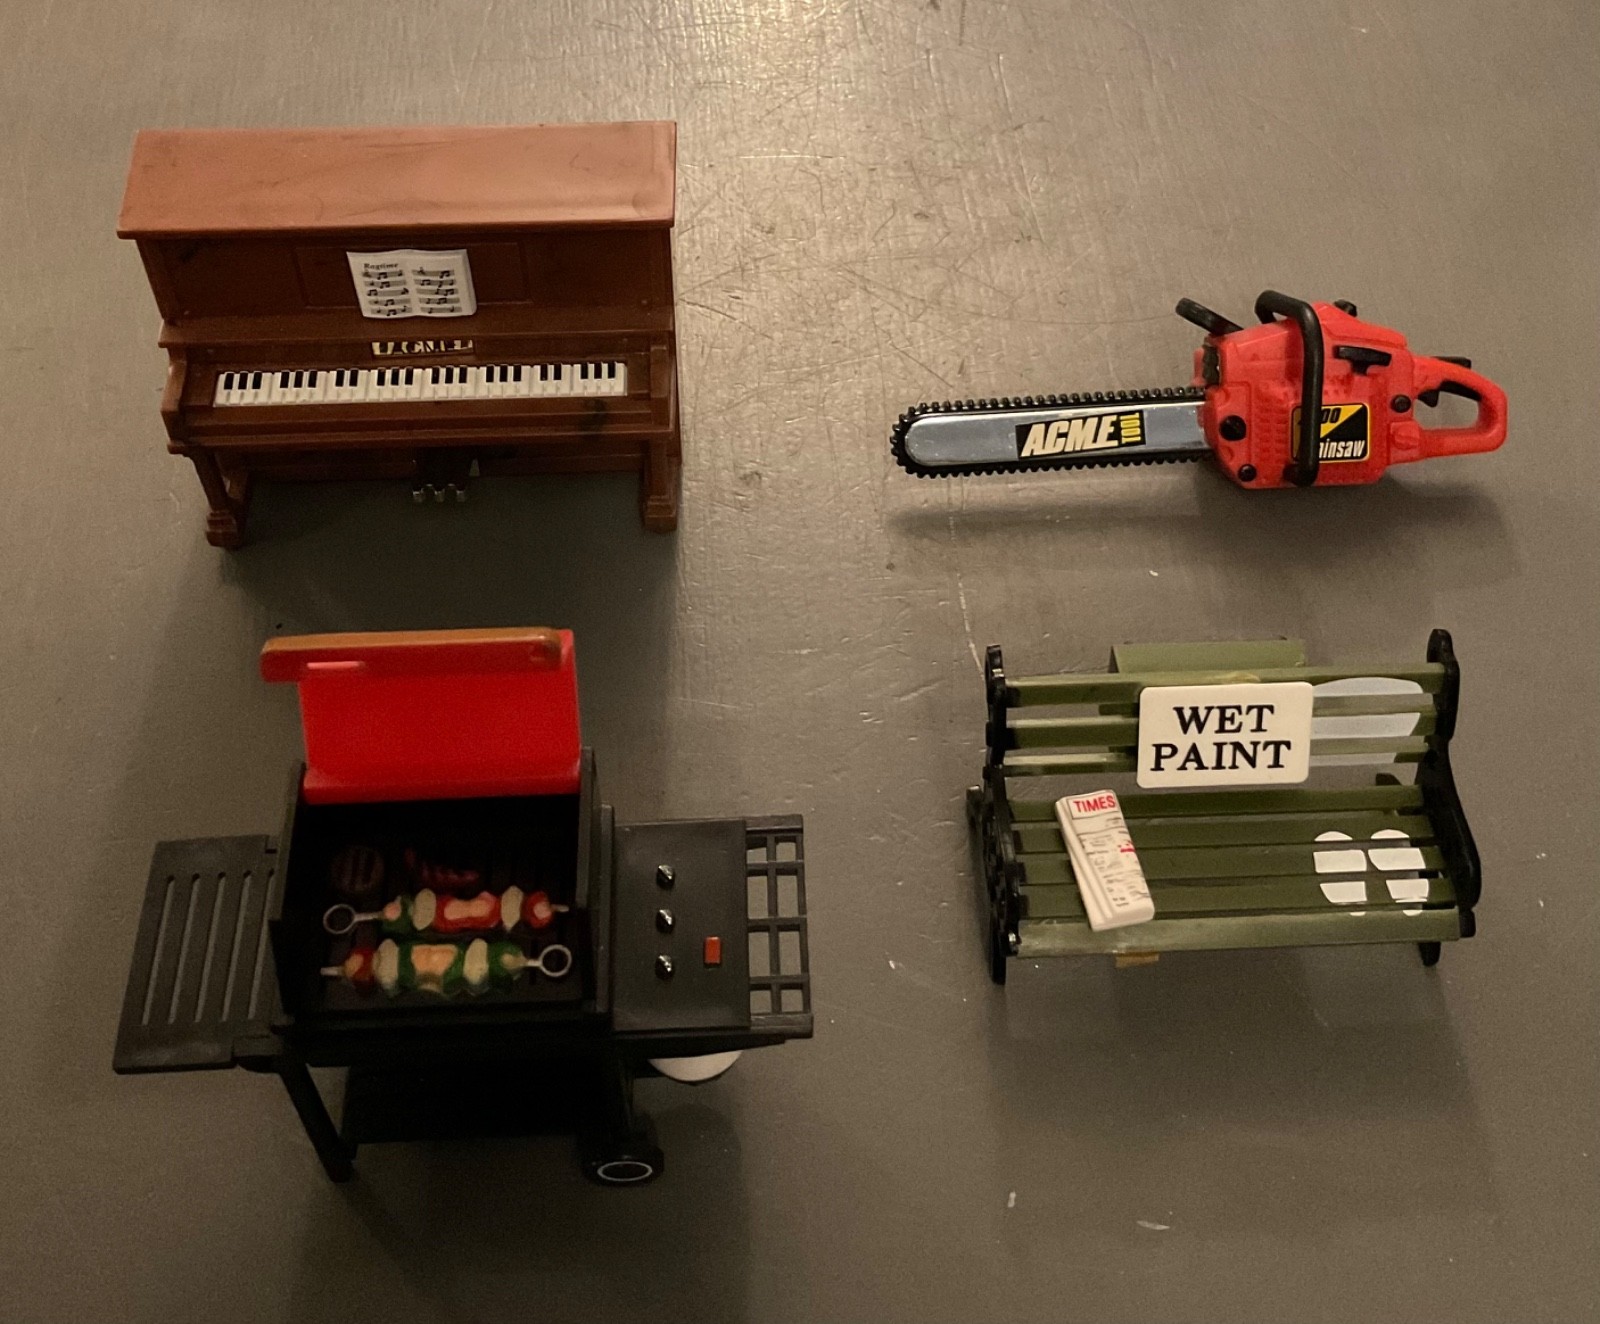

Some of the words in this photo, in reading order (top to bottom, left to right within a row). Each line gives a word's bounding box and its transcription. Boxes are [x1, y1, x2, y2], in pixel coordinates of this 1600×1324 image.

[363, 262, 399, 270] Ragtime
[1020, 414, 1119, 457] ACME
[1318, 438, 1365, 459] insaw
[1172, 704, 1275, 735] WET
[1150, 740, 1292, 772] PAINT
[1073, 795, 1116, 813] TIMES
